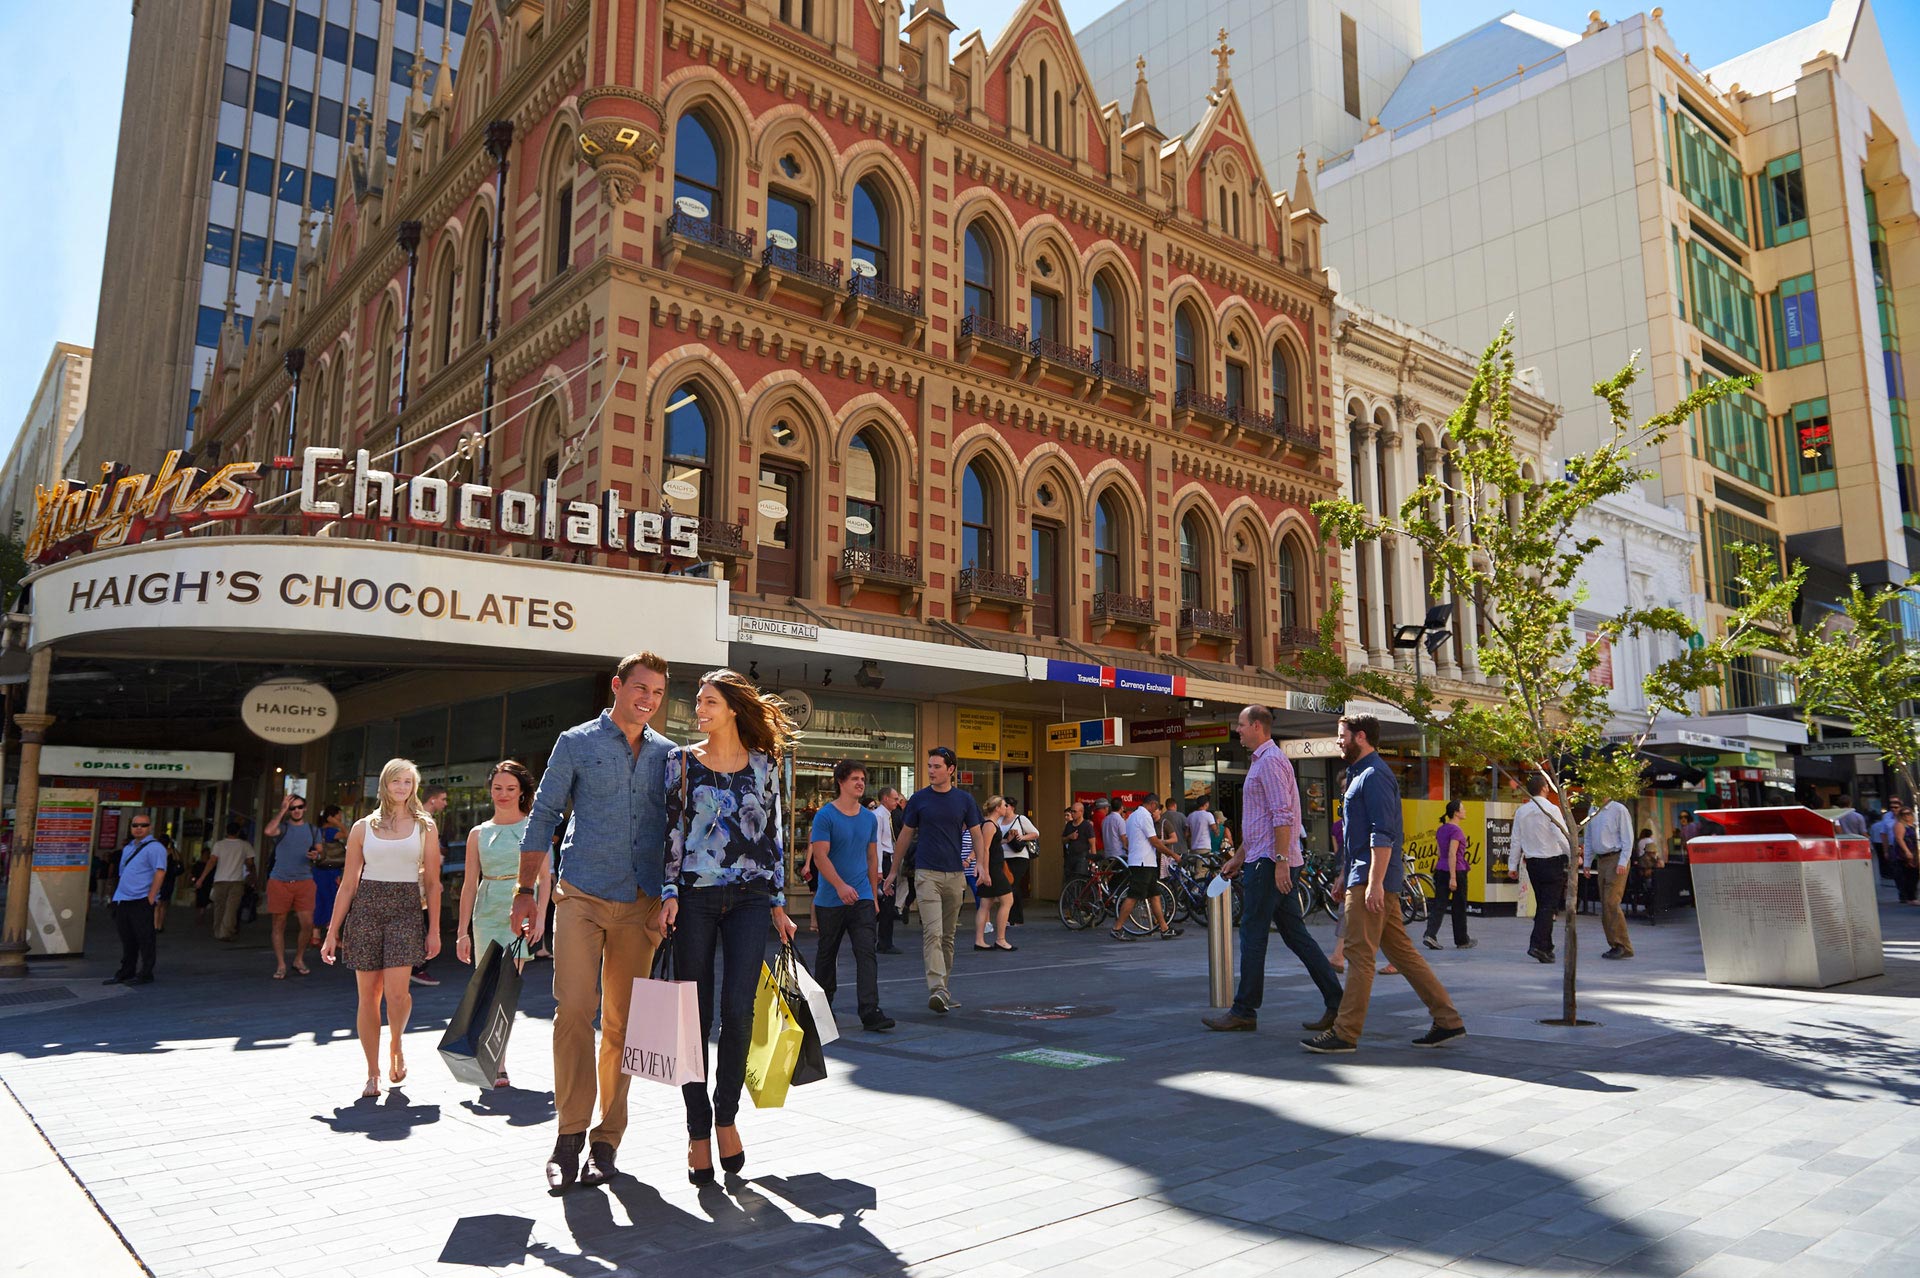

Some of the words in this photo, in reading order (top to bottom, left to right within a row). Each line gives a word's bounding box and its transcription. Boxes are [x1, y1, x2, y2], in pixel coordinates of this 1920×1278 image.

[301, 446, 700, 559] Chocolates
[68, 569, 263, 613] HAIGH'S
[280, 572, 577, 632] CHOCOLATES
[751, 620, 788, 634] RUNDLE
[791, 626, 815, 638] MALL
[1077, 674, 1100, 684] Travelex
[1121, 679, 1146, 691] Currency
[1146, 683, 1171, 694] Exchange
[256, 703, 327, 717] HAIGH'S
[264, 726, 316, 734] CHOCOLATES
[825, 725, 887, 741] HAIGH'S
[1166, 725, 1182, 734] atm
[834, 741, 879, 750] CHOCOLATES
[1803, 742, 1850, 752] G-STAR
[82, 761, 131, 770] OPALS
[144, 763, 184, 772] GIFTS
[622, 1046, 677, 1081] REVIEW
